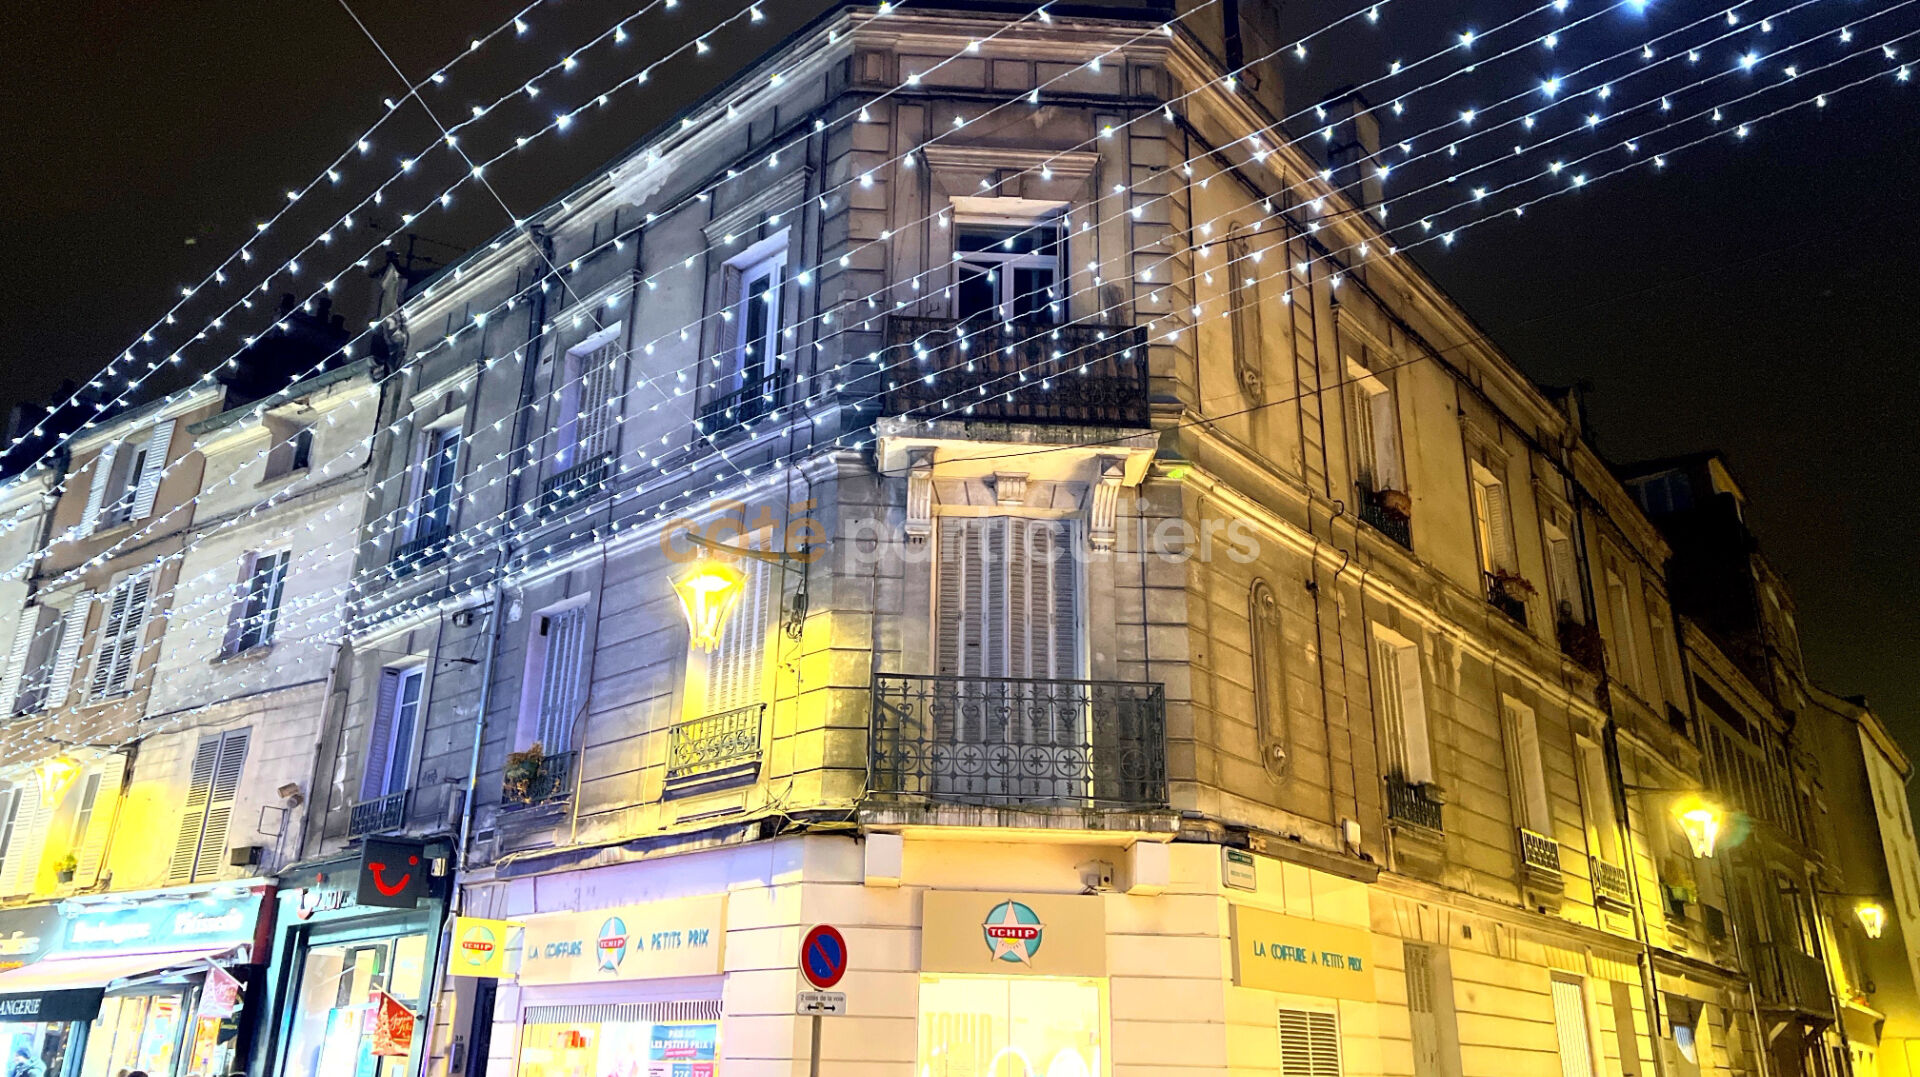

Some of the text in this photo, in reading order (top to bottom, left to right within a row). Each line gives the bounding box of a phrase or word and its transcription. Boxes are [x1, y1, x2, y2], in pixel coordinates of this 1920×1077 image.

[651, 931, 681, 951] PETITS
[688, 929, 709, 948] PRIX
[990, 929, 1035, 938] TCHIP
[600, 938, 624, 948] TCHIP
[1253, 940, 1363, 972] LA COIFFURE A PETITS PRIX
